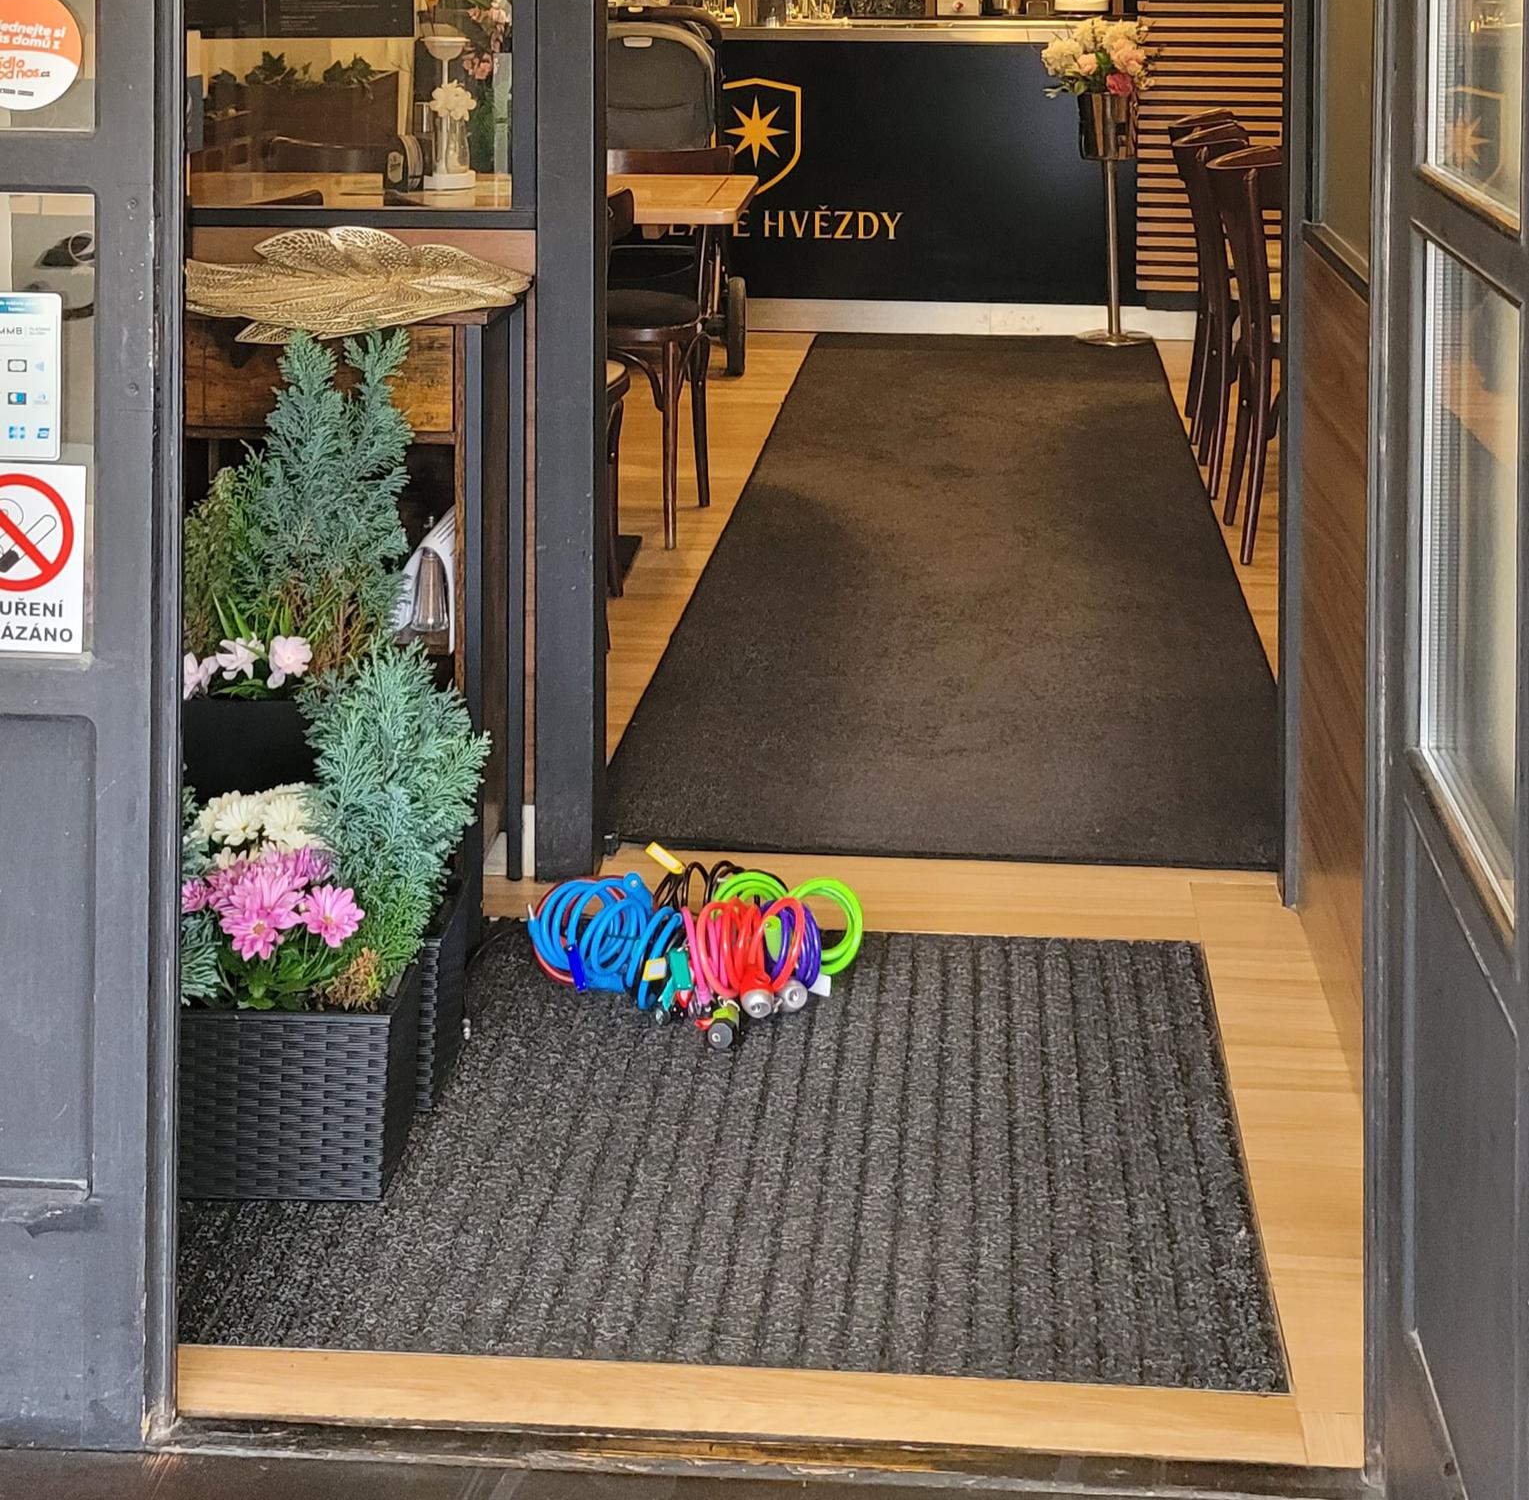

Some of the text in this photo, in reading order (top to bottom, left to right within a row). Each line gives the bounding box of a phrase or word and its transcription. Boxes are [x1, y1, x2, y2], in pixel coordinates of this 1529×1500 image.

[764, 205, 904, 240] HVĚZDY
[0, 597, 64, 618] UŘENÍ
[0, 621, 73, 643] ÁZÁNO
